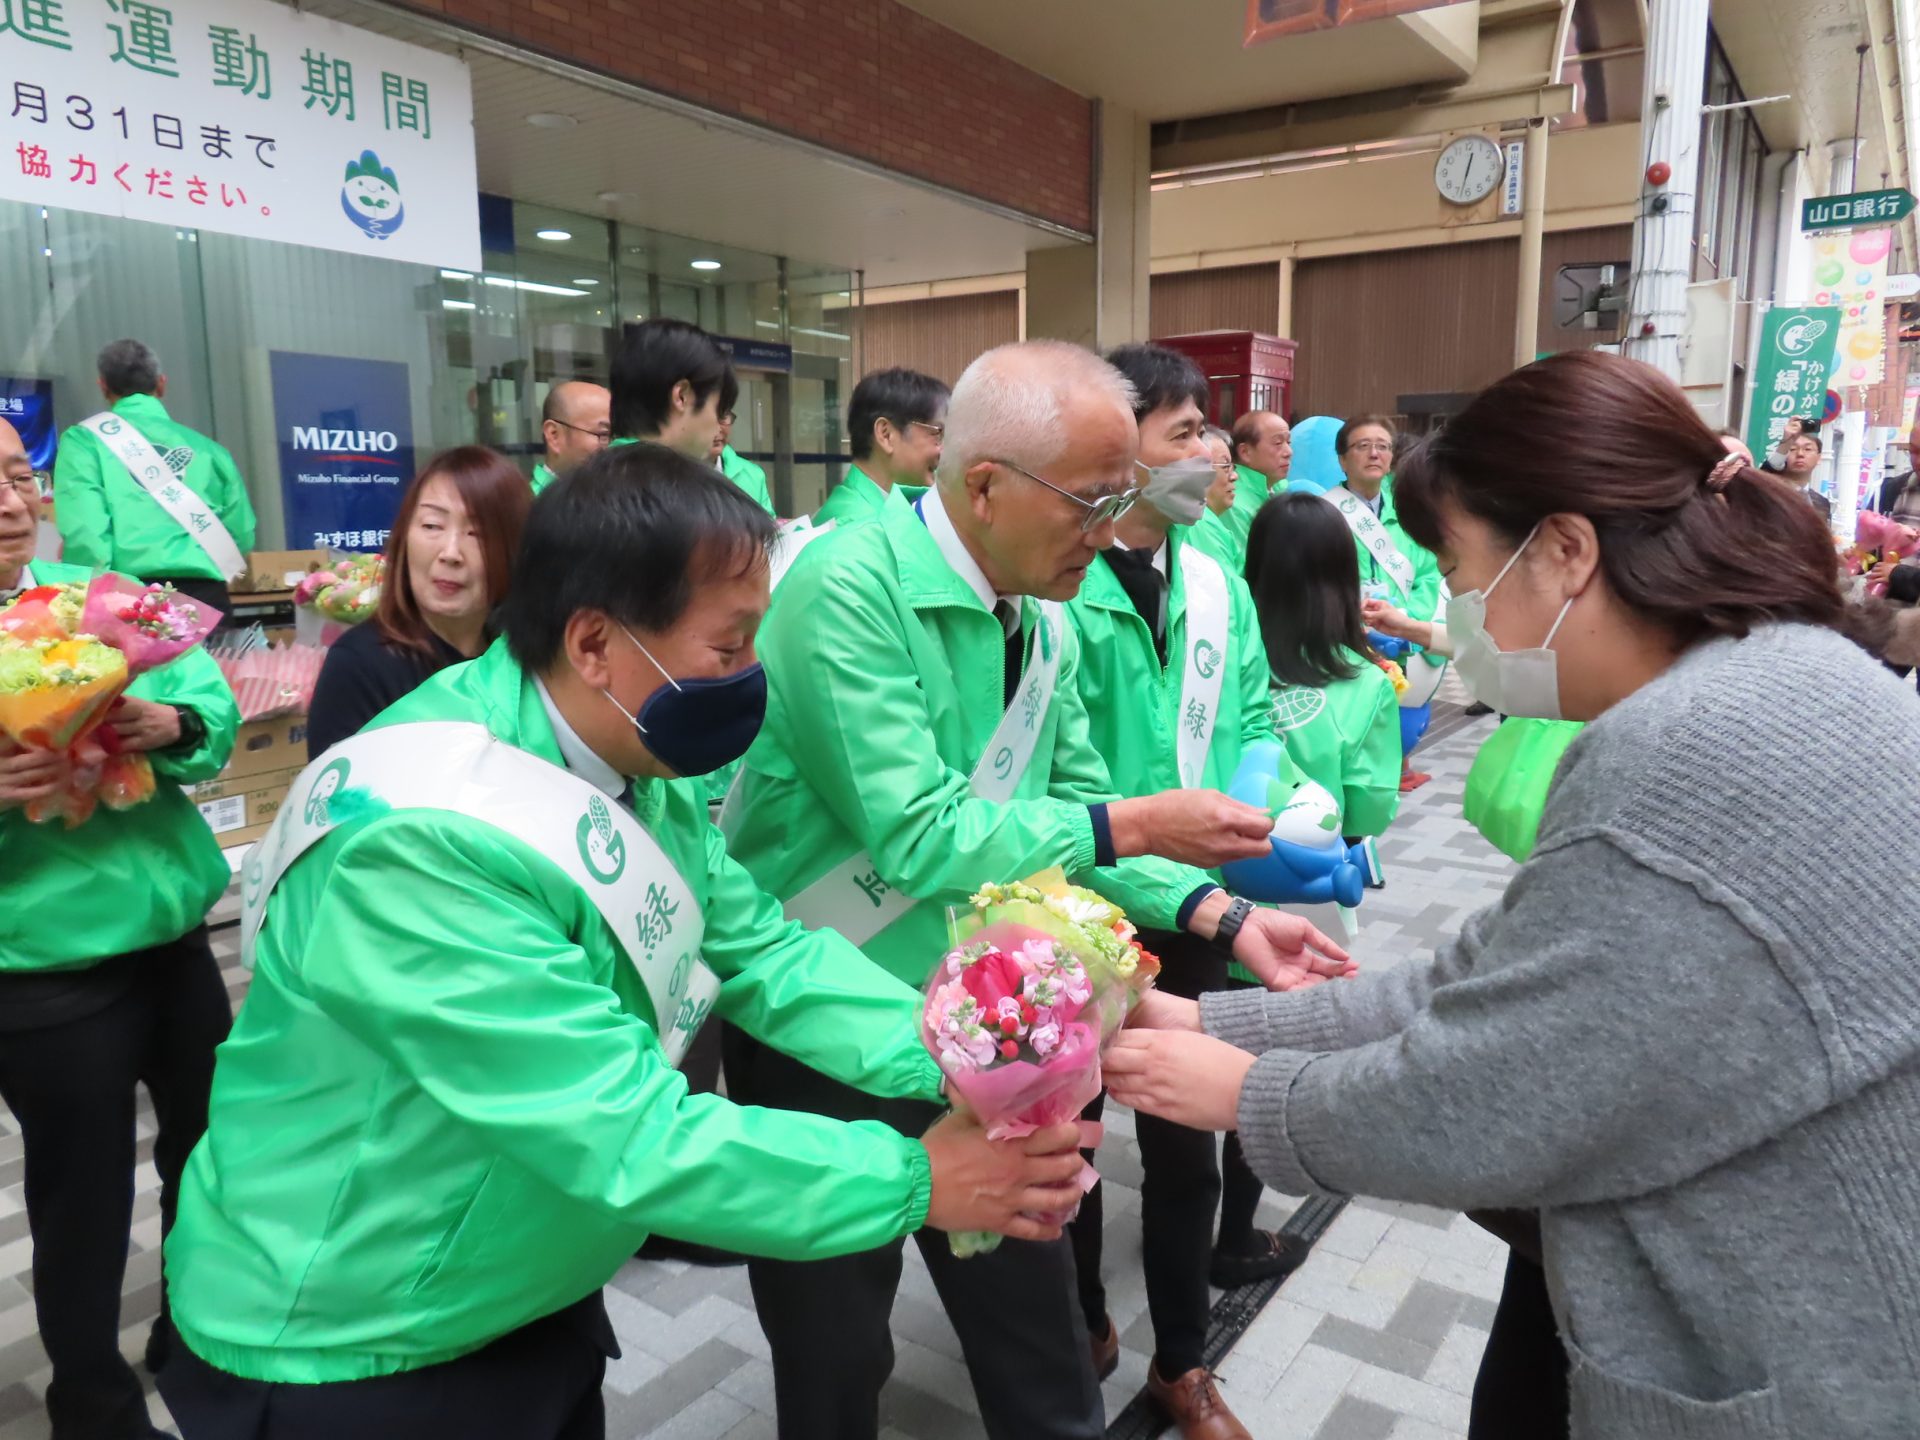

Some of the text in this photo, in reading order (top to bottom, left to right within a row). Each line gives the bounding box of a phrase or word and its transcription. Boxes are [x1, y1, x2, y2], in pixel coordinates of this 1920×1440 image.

[11, 81, 276, 169] 月31日まで
[16, 141, 271, 216] 協力ください。
[1809, 194, 1900, 223] 山口銀行
[292, 426, 398, 452] MIZUHO
[298, 474, 400, 485] Mizuho Financial Group
[313, 529, 391, 548] みずほ銀行
